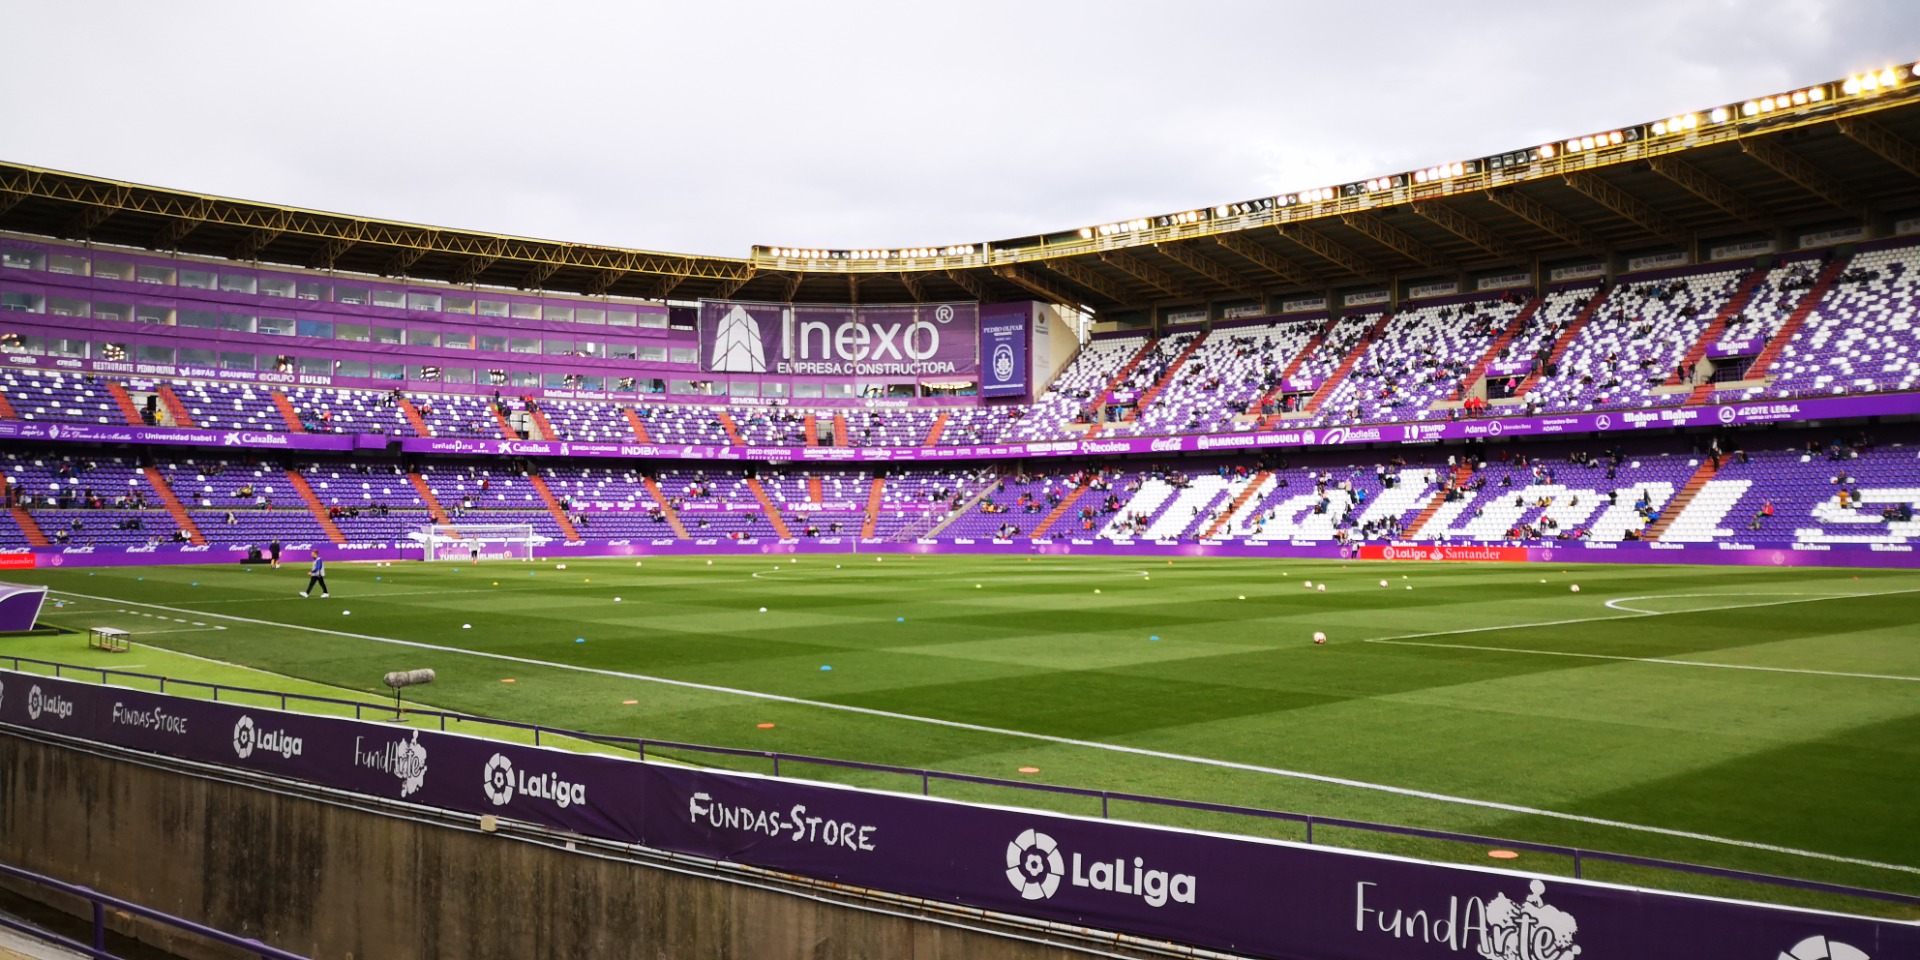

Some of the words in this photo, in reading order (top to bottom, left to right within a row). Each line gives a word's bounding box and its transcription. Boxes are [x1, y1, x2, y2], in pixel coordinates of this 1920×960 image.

[782, 309, 940, 361] Inexo
[92, 361, 134, 372] RESTAURANTE
[777, 362, 842, 374] EMPRESA
[844, 361, 955, 375] CONSTRUCTORA
[266, 374, 295, 383] GRUPO
[300, 375, 331, 385] EULEN
[1623, 411, 1658, 422] Mahou
[1661, 409, 1697, 420] Mahou
[145, 433, 190, 441] Universidad
[190, 433, 213, 441] Isabel
[242, 433, 288, 444] CaixaBank
[1209, 436, 1254, 447] ALMACENES
[512, 443, 551, 453] CaixaBank
[621, 446, 660, 456] INDIBA
[1090, 441, 1131, 452] Recoletas
[477, 553, 504, 561] IRLINES
[1396, 549, 1427, 560] LaLiga
[1445, 548, 1501, 560] Santander
[43, 696, 73, 719] LaLiga
[257, 728, 303, 759] LaLiga
[355, 736, 422, 778] FundArte
[518, 770, 586, 808] LaLiga
[1072, 853, 1196, 908] LaLiga
[1355, 881, 1557, 960] FundArte
